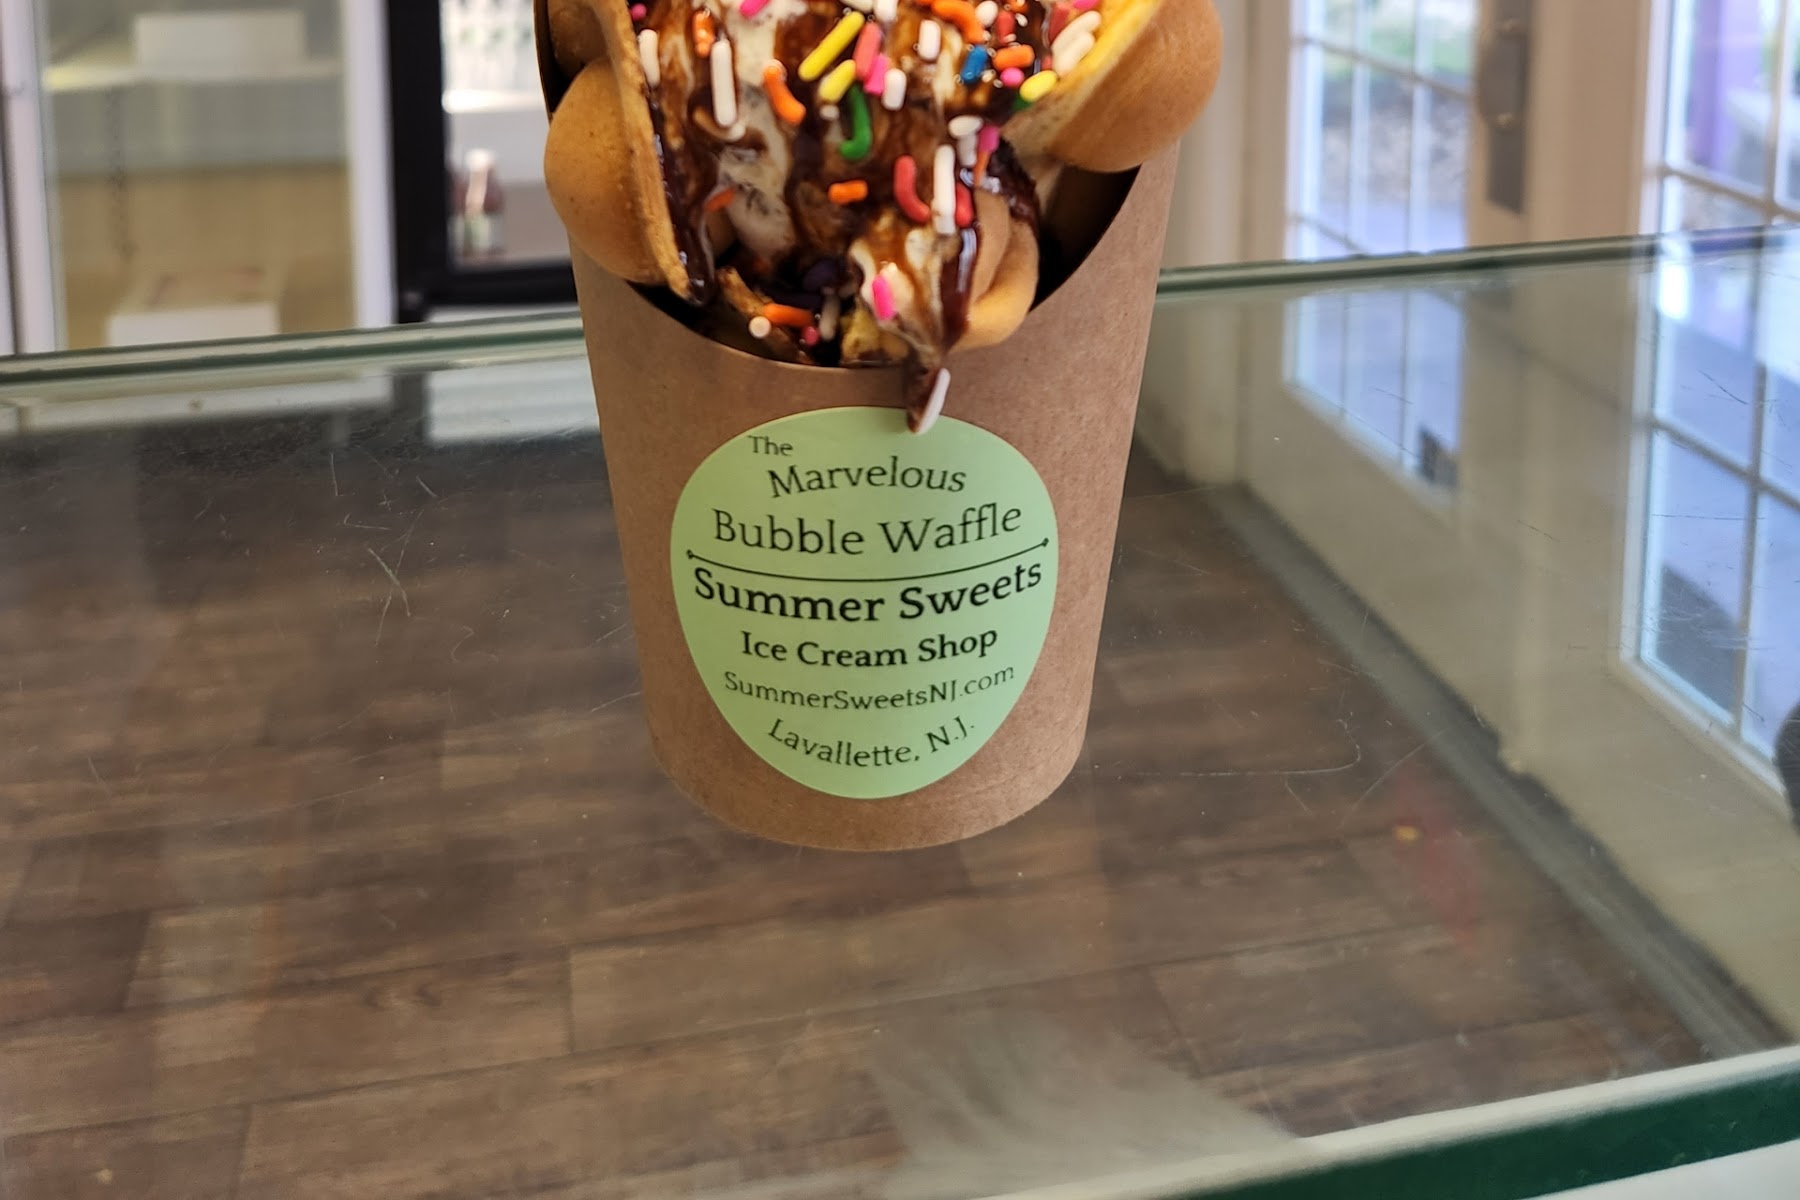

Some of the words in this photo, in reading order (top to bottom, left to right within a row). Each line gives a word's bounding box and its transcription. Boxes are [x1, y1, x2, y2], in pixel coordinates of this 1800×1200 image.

[748, 435, 793, 456] The
[768, 455, 967, 498] Marvelous
[712, 508, 864, 555] Bubble
[879, 502, 1022, 553] Waffle
[694, 567, 885, 621] Summer
[899, 563, 1041, 619] Sweets
[741, 631, 787, 661] Ice
[797, 642, 907, 667] Cream
[918, 630, 997, 662] Shop
[724, 666, 1014, 710] SummerSweetsNJ.com
[927, 716, 974, 753] N.J.
